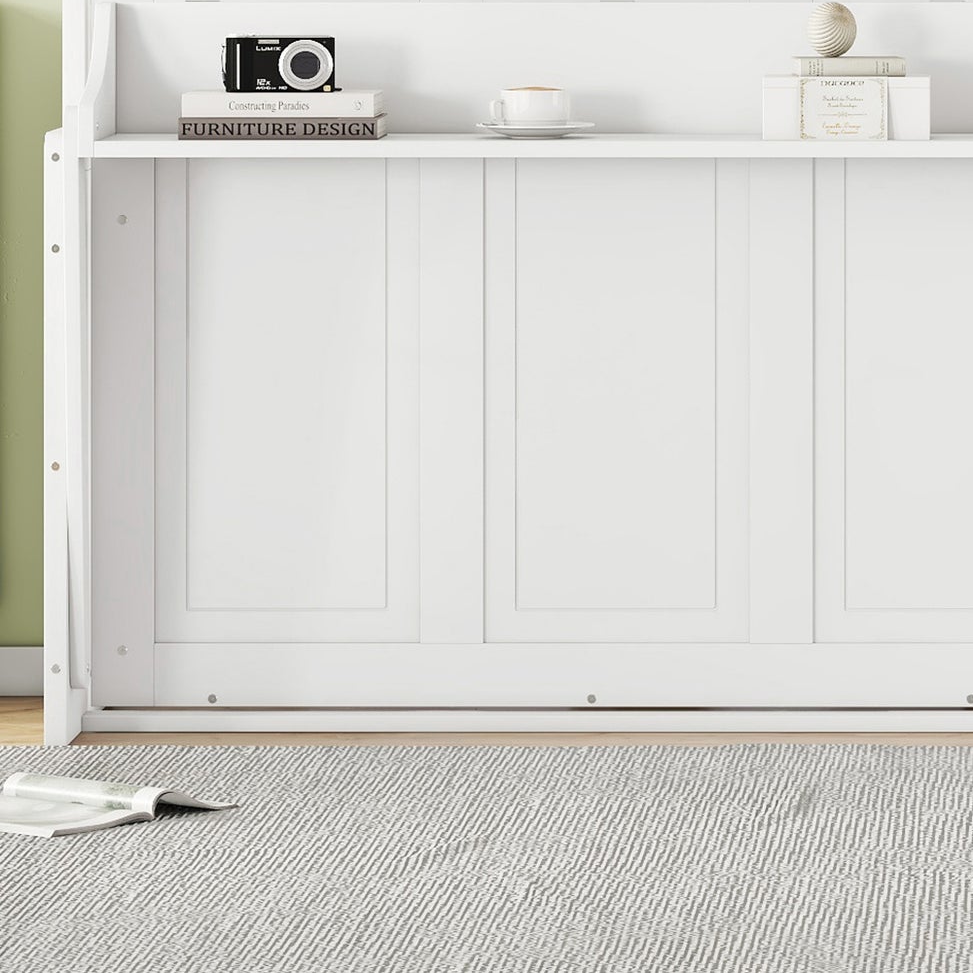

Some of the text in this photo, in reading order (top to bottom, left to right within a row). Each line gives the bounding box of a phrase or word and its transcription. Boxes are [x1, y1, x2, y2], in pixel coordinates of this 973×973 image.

[228, 100, 310, 112] Constructing Paradies
[182, 123, 375, 136] FURNITURE DESIGN
